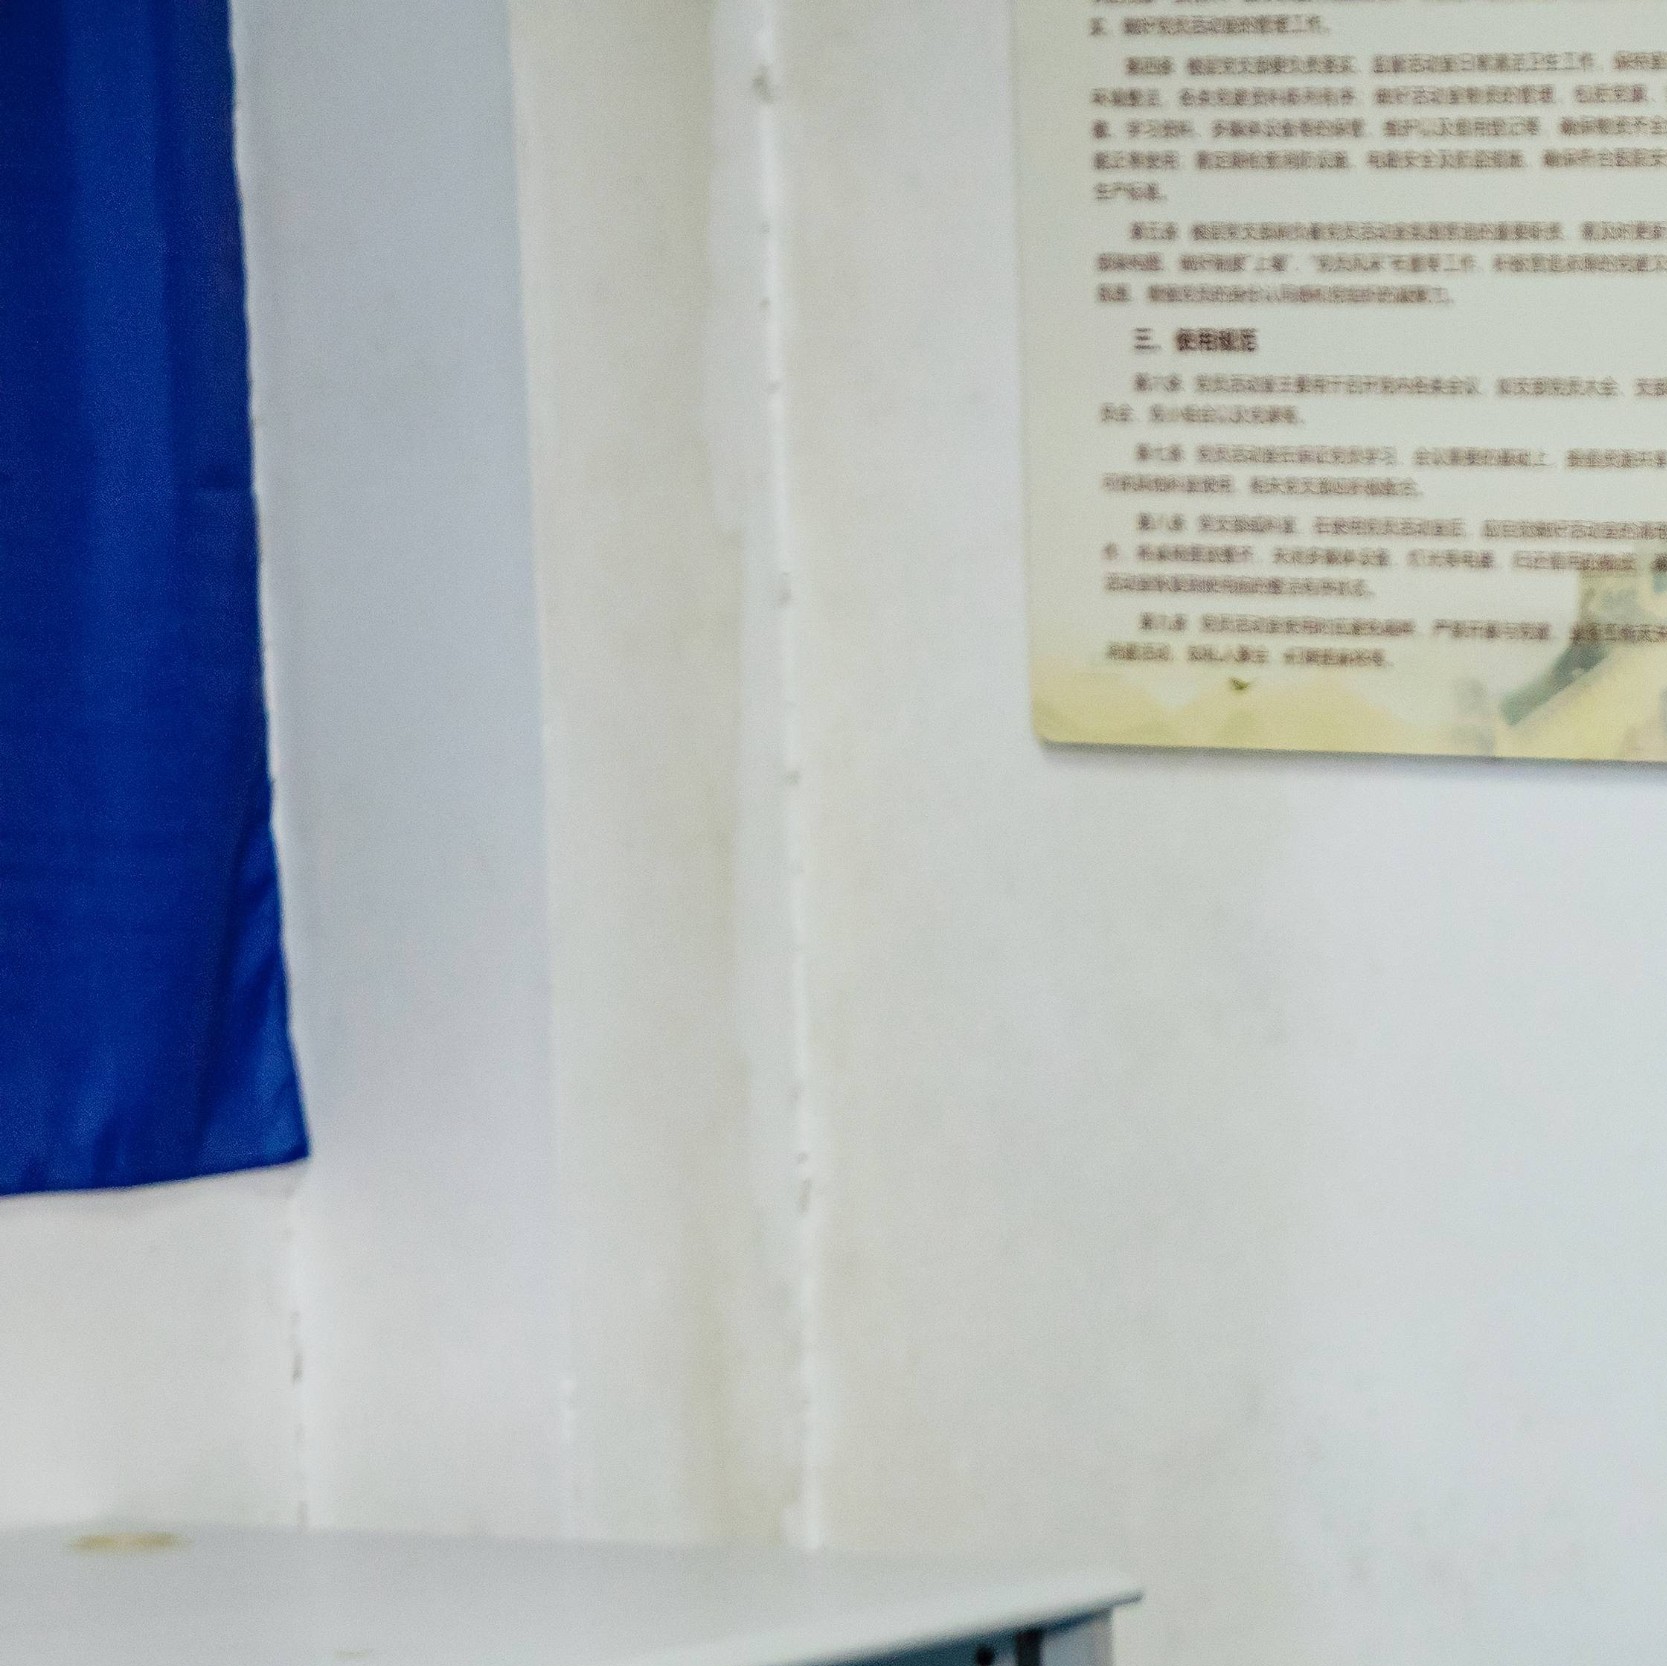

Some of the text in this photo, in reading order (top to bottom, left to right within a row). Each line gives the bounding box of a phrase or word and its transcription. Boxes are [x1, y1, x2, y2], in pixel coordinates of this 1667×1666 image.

[1132, 327, 1259, 354] 三、使用规范
